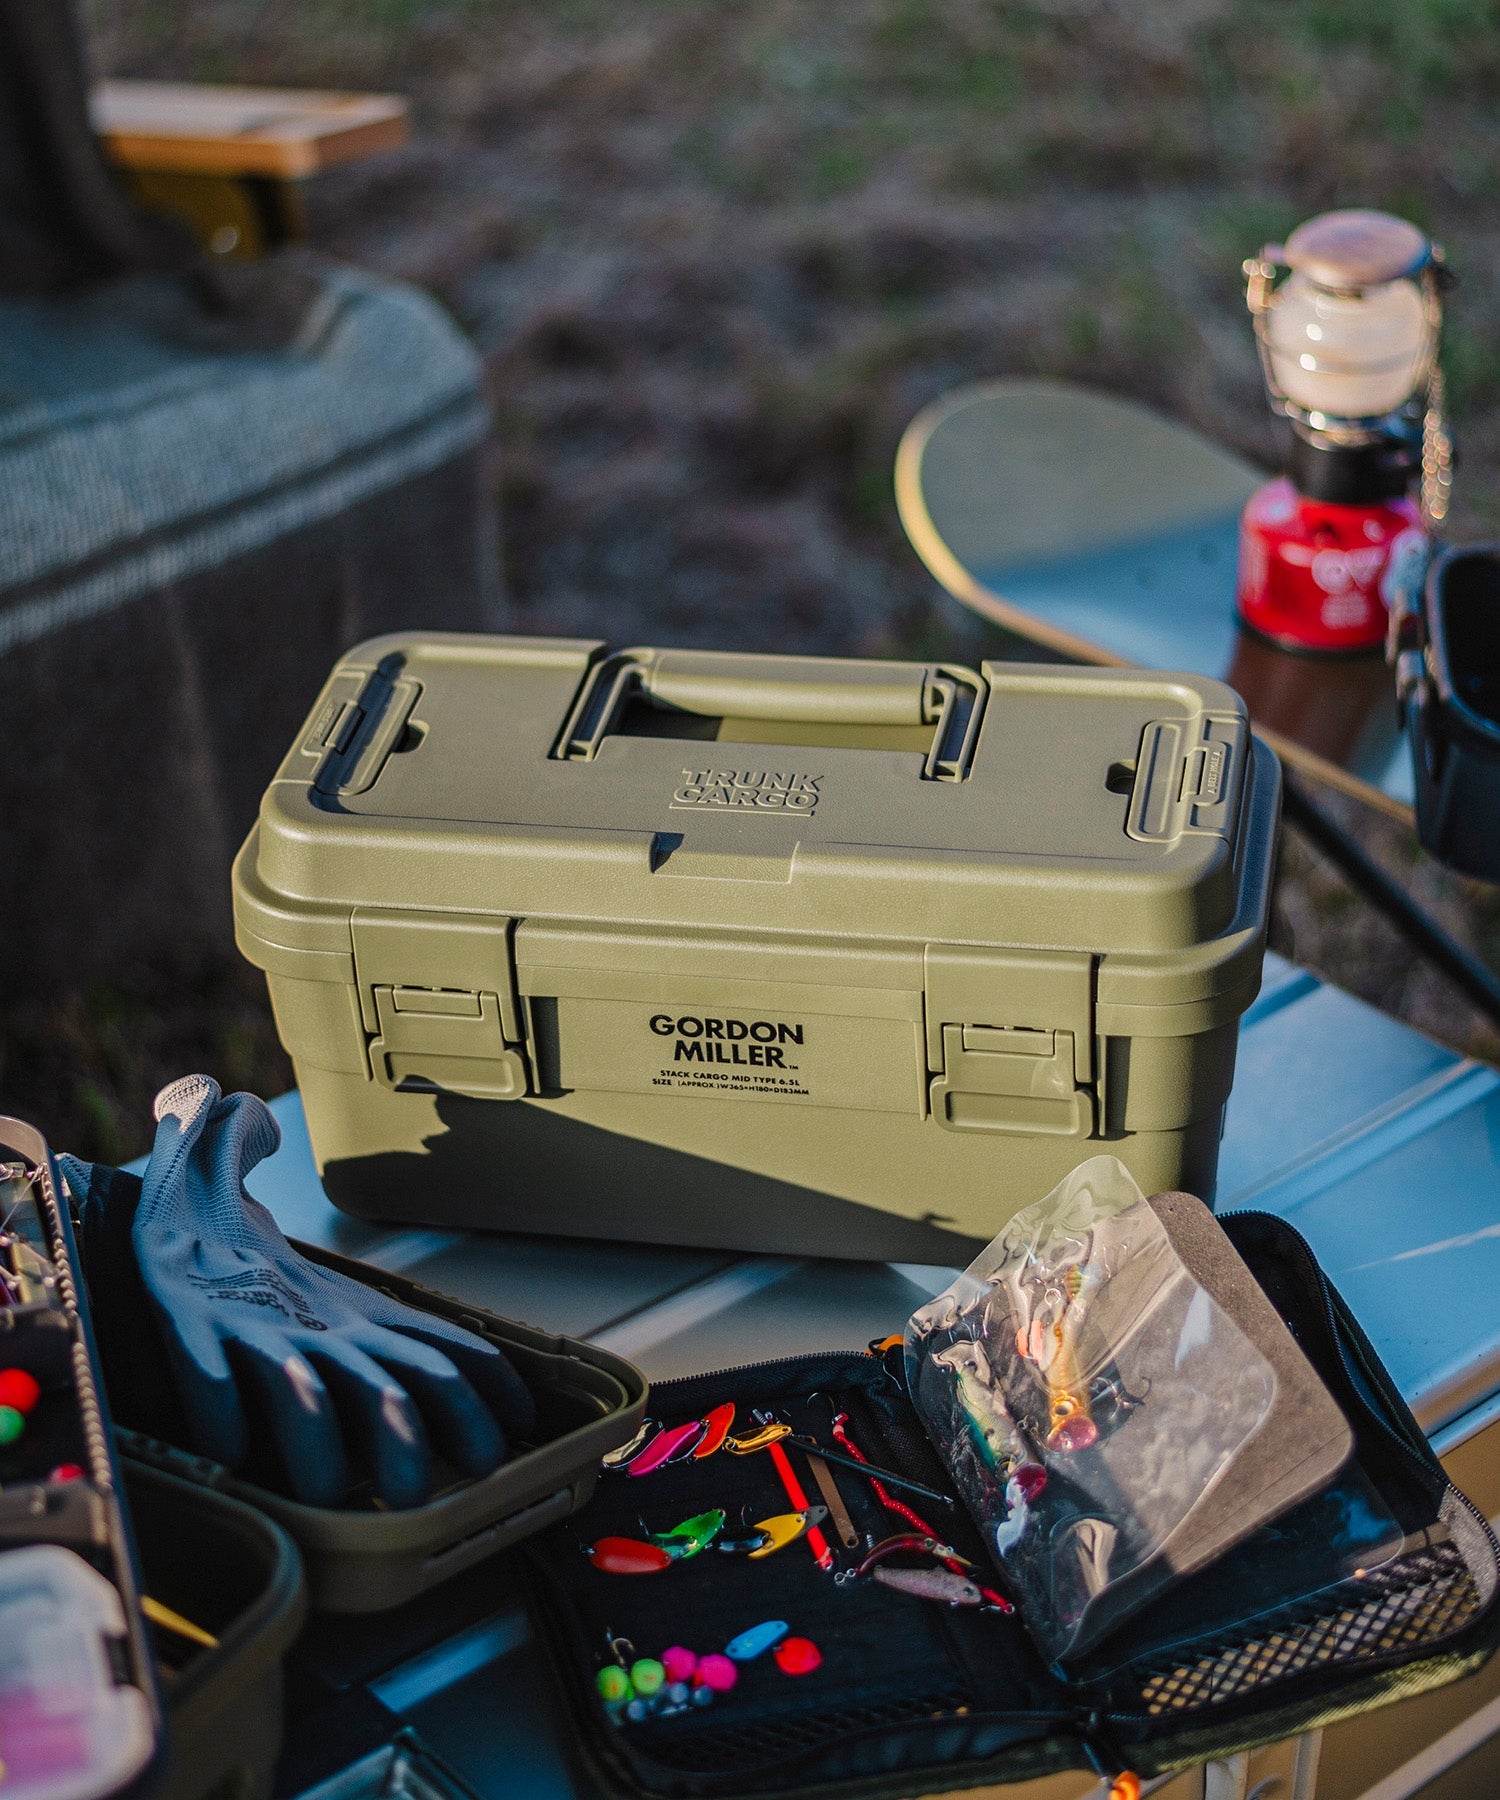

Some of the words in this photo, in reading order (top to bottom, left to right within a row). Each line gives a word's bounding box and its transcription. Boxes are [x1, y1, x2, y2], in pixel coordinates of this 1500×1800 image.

[682, 768, 824, 793] TRUNK
[673, 787, 820, 810] CARGO
[649, 1014, 804, 1045] GORDON
[674, 1039, 788, 1069] MILLER
[652, 1078, 672, 1086] SIZE
[660, 1069, 690, 1078] STACK
[693, 1072, 729, 1081] CARGO
[731, 1074, 751, 1082] MID
[753, 1076, 776, 1084] TYPE
[778, 1078, 800, 1086] 6.5L
